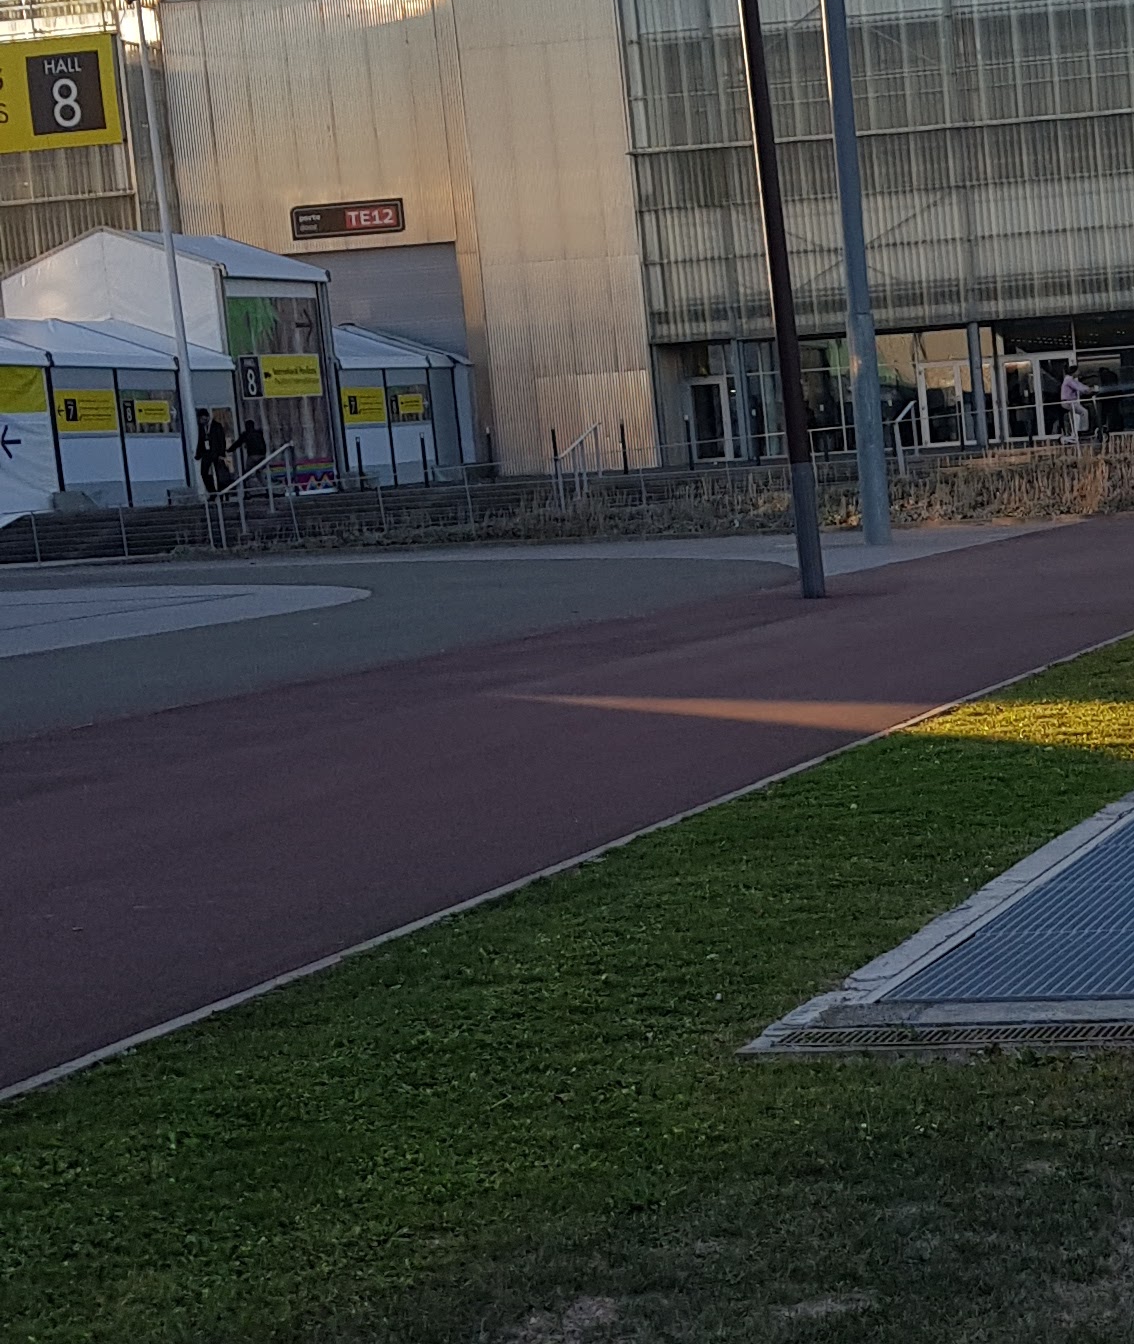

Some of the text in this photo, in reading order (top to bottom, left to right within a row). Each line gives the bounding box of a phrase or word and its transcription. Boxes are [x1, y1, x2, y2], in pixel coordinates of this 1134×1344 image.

[43, 56, 82, 75] HALL
[52, 77, 82, 128] 8
[346, 208, 394, 227] TE12
[246, 368, 257, 396] 8
[67, 405, 74, 420] 7
